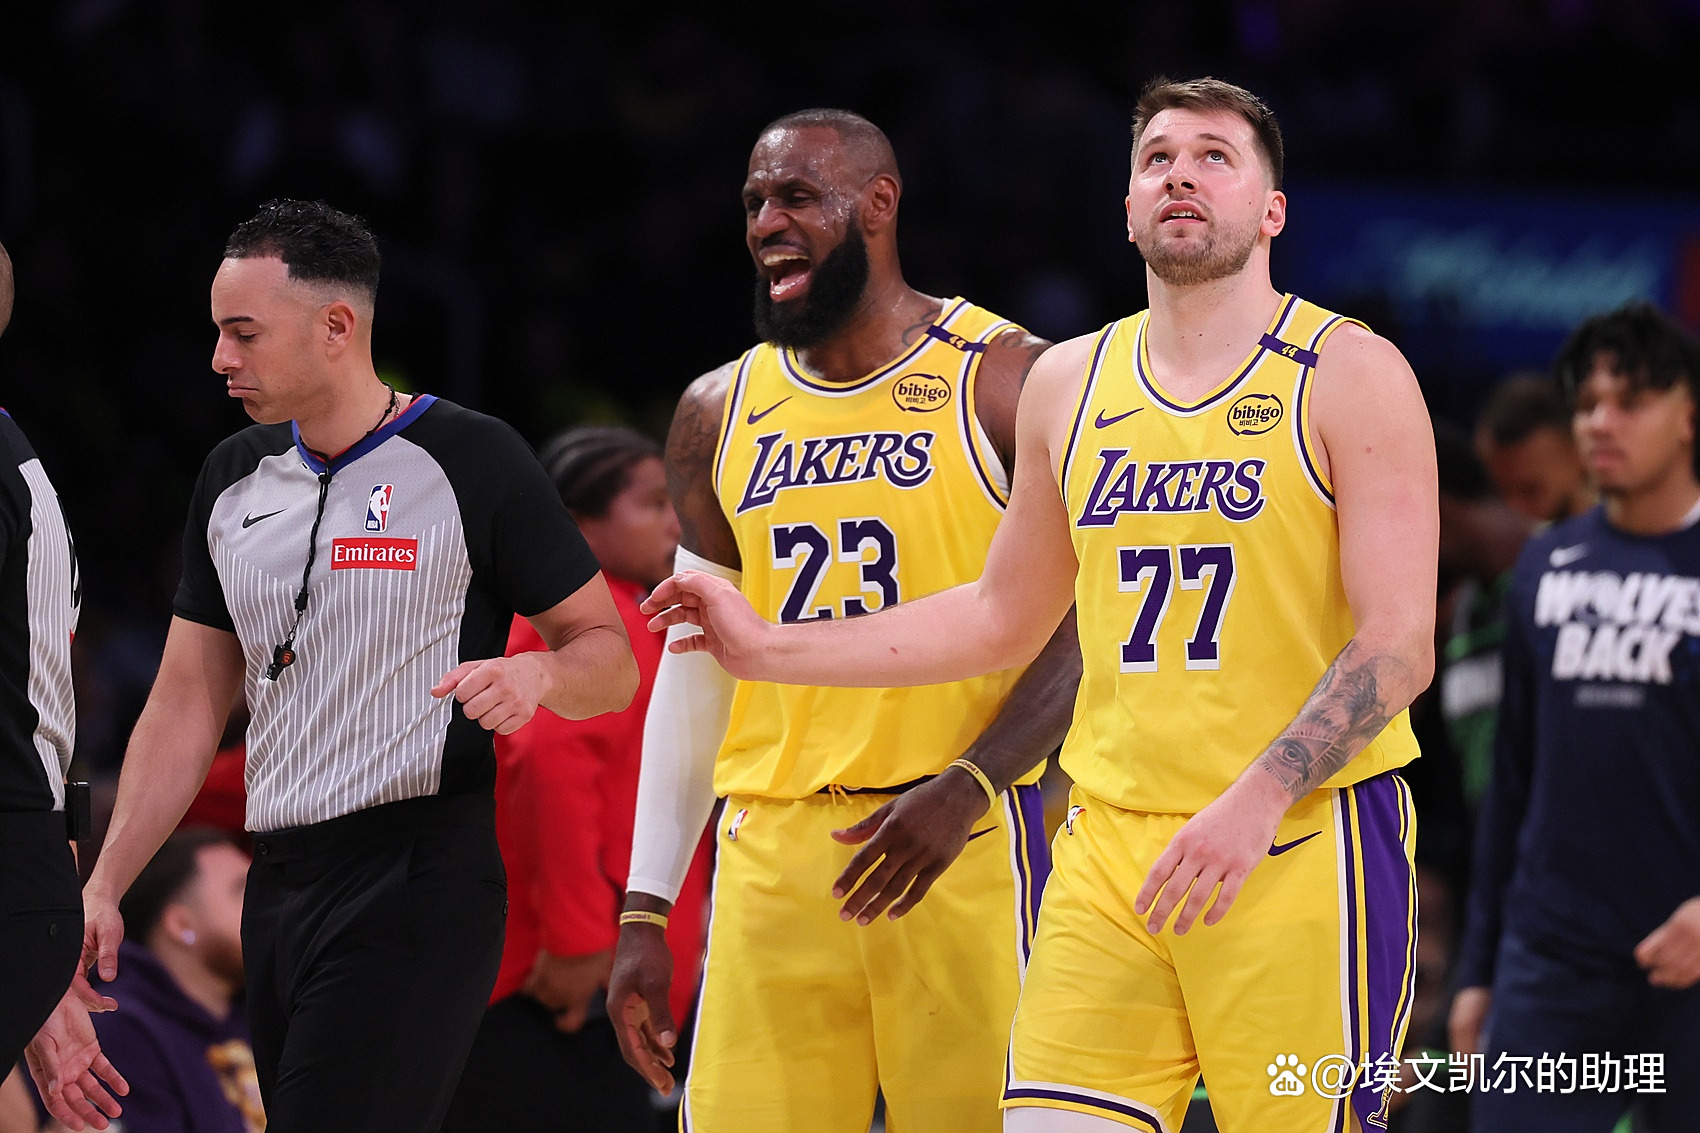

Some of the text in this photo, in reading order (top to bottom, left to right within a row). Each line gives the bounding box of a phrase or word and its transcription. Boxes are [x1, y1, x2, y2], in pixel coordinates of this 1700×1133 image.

[1281, 345, 1299, 357] 44
[898, 383, 947, 402] bibigo
[1232, 405, 1280, 422] bibigo
[735, 429, 937, 518] LAKERS
[1075, 447, 1268, 529] LAKERS
[334, 543, 415, 563] Emirates
[770, 516, 901, 624] 23
[1116, 542, 1237, 673] 77
[1552, 623, 1682, 683] BACK
